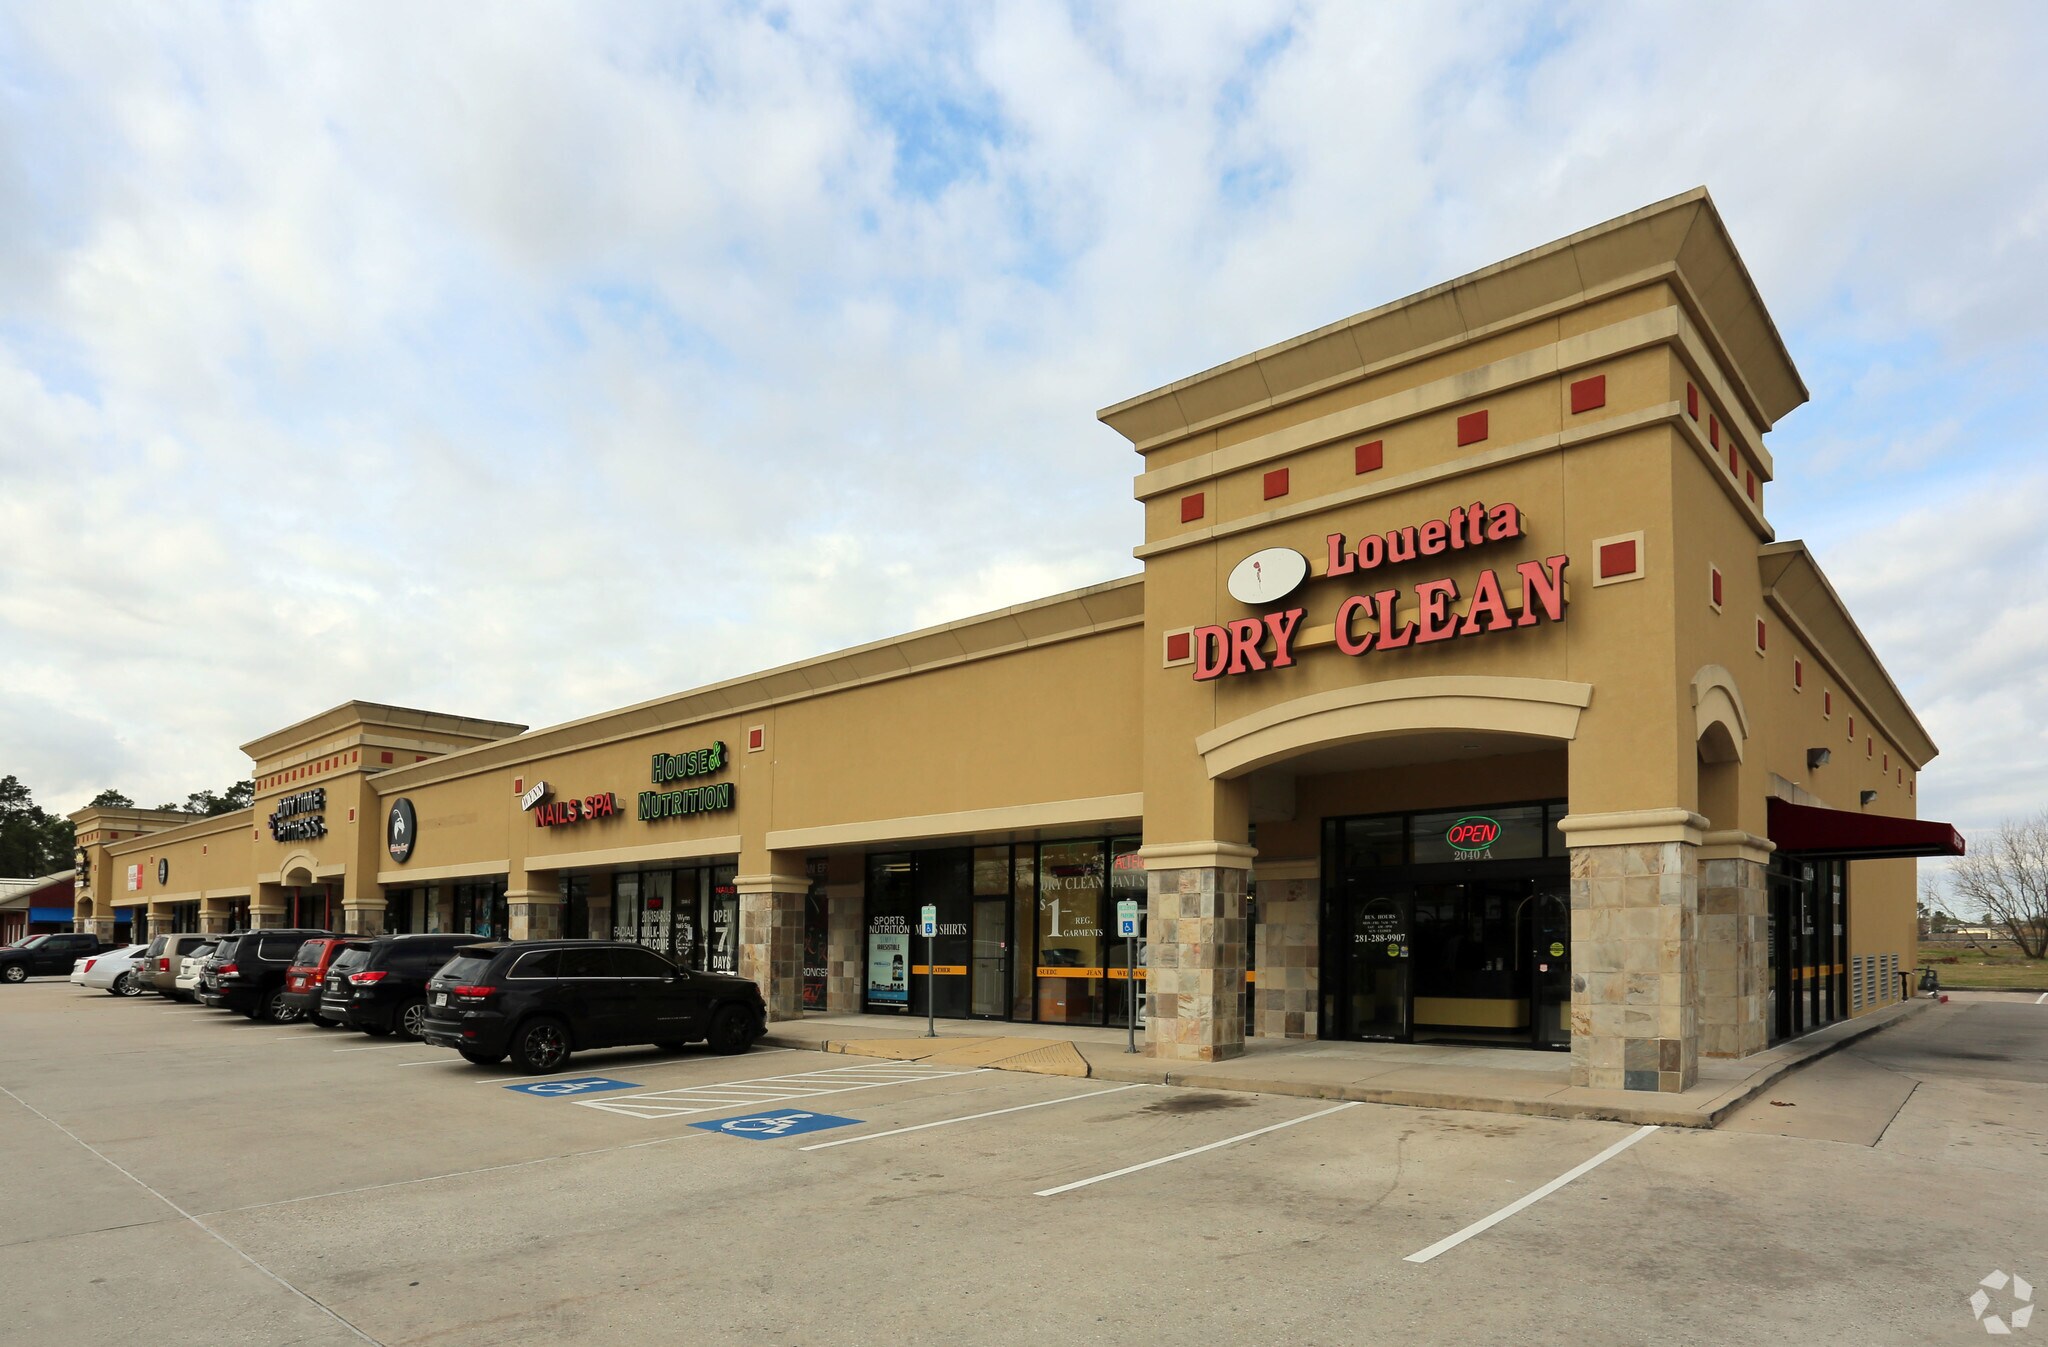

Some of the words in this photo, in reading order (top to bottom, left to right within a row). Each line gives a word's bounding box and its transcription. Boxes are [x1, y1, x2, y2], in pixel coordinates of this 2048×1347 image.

[1326, 500, 1522, 578] Louetta
[1192, 607, 1308, 682] DRY
[1334, 554, 1570, 657] CLEAN
[276, 789, 322, 819] ANYTIME
[637, 782, 732, 821] NUTRITION
[534, 799, 579, 828] NAILS
[584, 792, 616, 820] SPA
[277, 816, 321, 842] FITNESS
[1449, 824, 1498, 843] OPEN
[1454, 850, 1481, 861] 2040
[1483, 849, 1494, 860] A
[1040, 879, 1062, 891] DRY
[1065, 875, 1105, 890] CLEAN
[713, 910, 733, 923] OPEN
[873, 916, 905, 926] SPORTS
[1075, 917, 1093, 925] REG.
[641, 926, 670, 938] WALK-INS
[868, 925, 911, 935] NUTRITION
[939, 923, 967, 935] SHIRTS
[1063, 929, 1104, 937] GARMENTS
[640, 939, 670, 950] WELCOME
[715, 926, 729, 952] 7
[1354, 933, 1406, 943] 281-288-9907
[713, 955, 731, 969] DAYS
